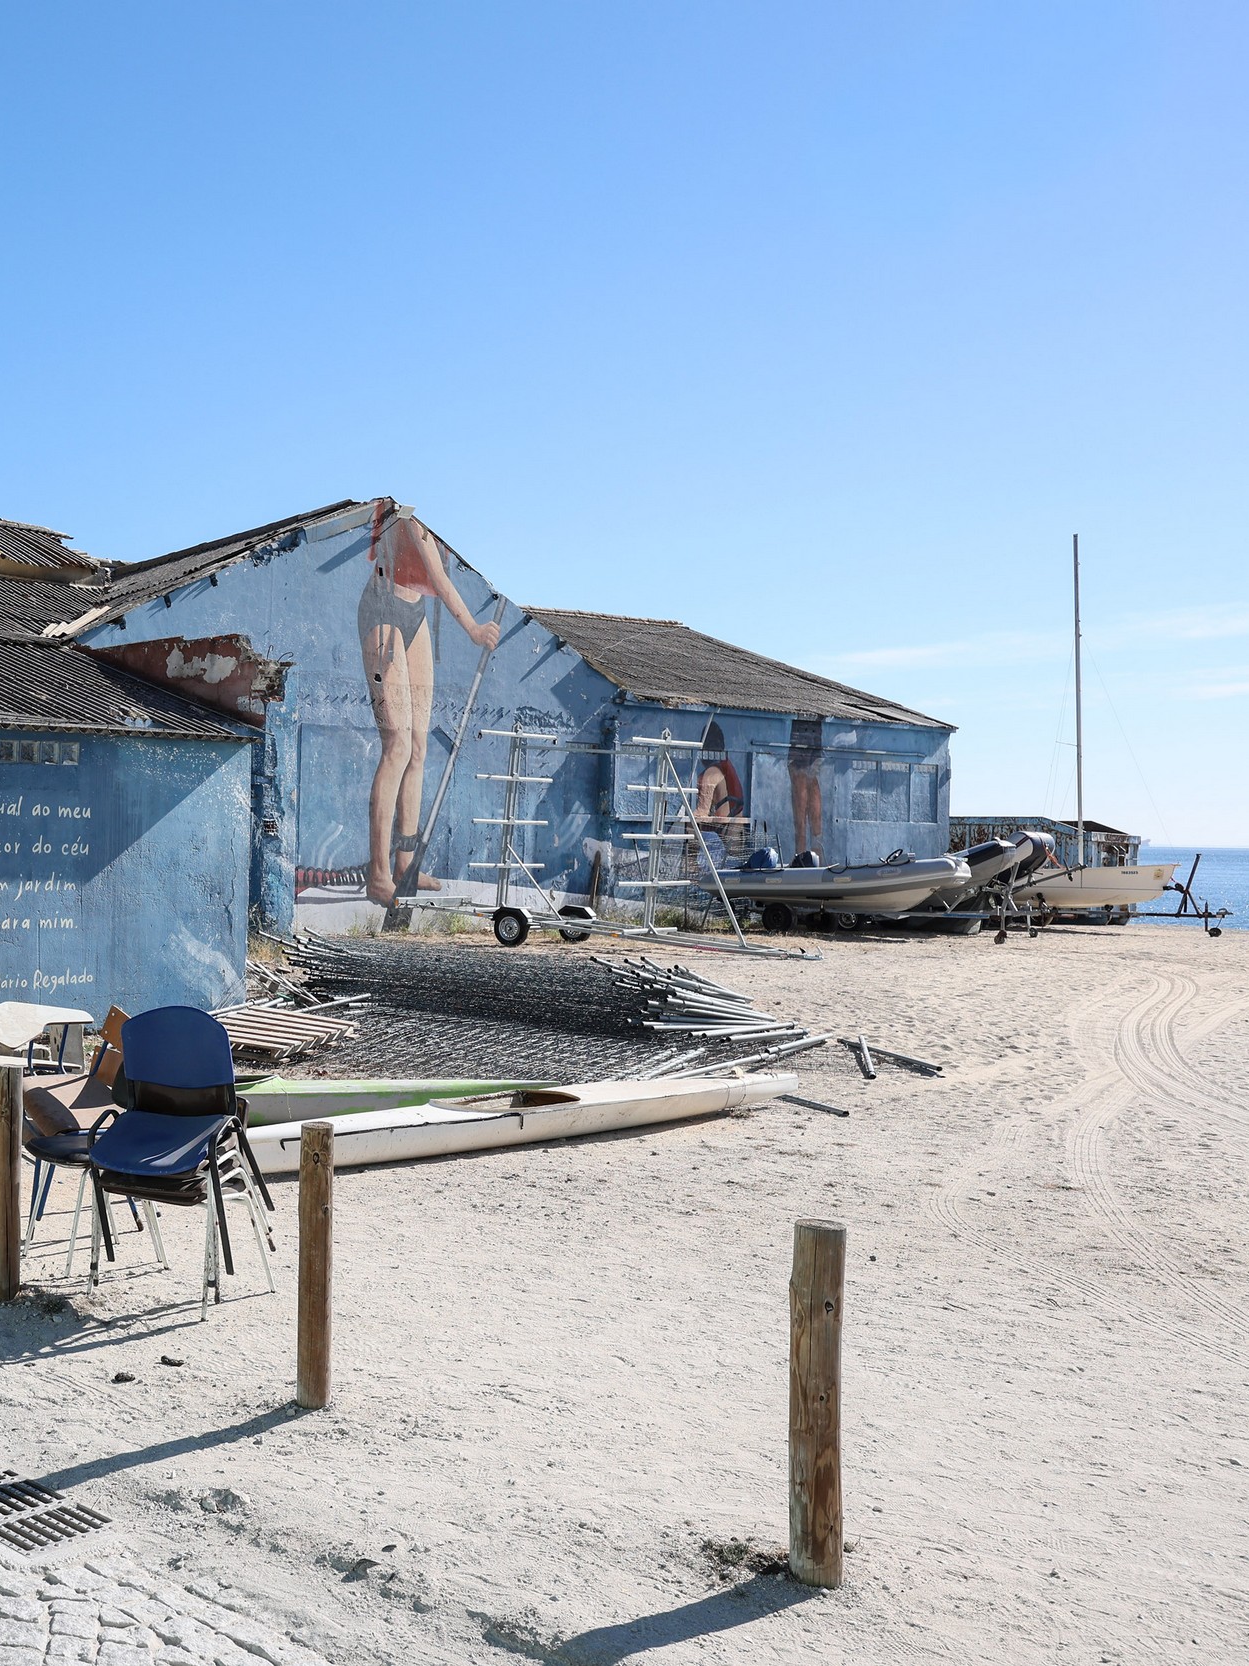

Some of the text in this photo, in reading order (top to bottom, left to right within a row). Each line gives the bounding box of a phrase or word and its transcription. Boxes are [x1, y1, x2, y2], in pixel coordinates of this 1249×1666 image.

[32, 804, 50, 817] ao
[58, 804, 91, 819] meu
[32, 835, 52, 855] do
[61, 836, 89, 856] céu
[14, 872, 76, 902] jardim
[39, 911, 79, 930] mim.
[33, 968, 94, 994] Regalado
